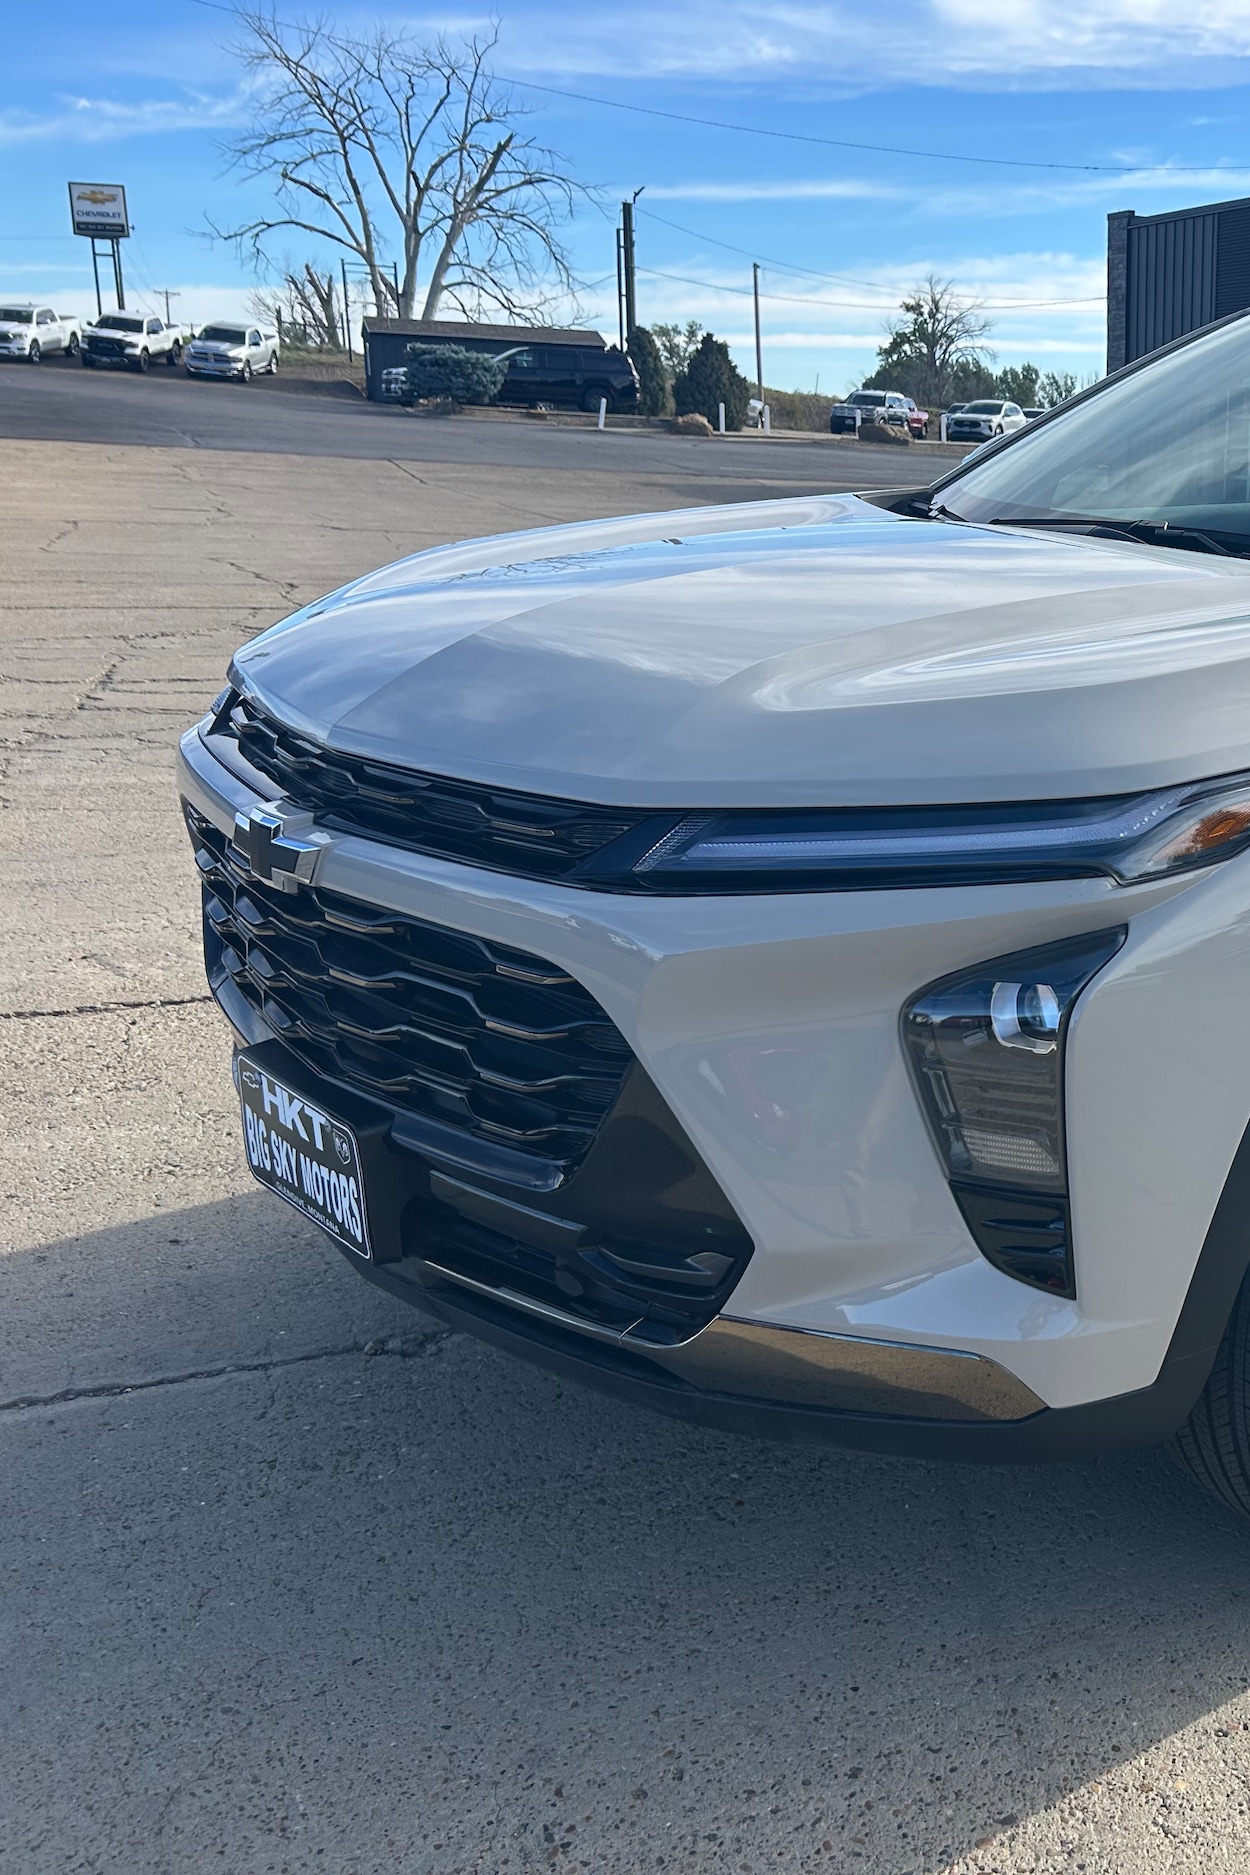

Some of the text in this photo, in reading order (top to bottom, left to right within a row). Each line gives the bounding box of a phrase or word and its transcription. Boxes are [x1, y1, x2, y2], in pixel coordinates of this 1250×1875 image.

[76, 210, 122, 218] CHEVROLET
[260, 1073, 327, 1151] HKT
[245, 1103, 363, 1244] BIG SKY MOTORS
